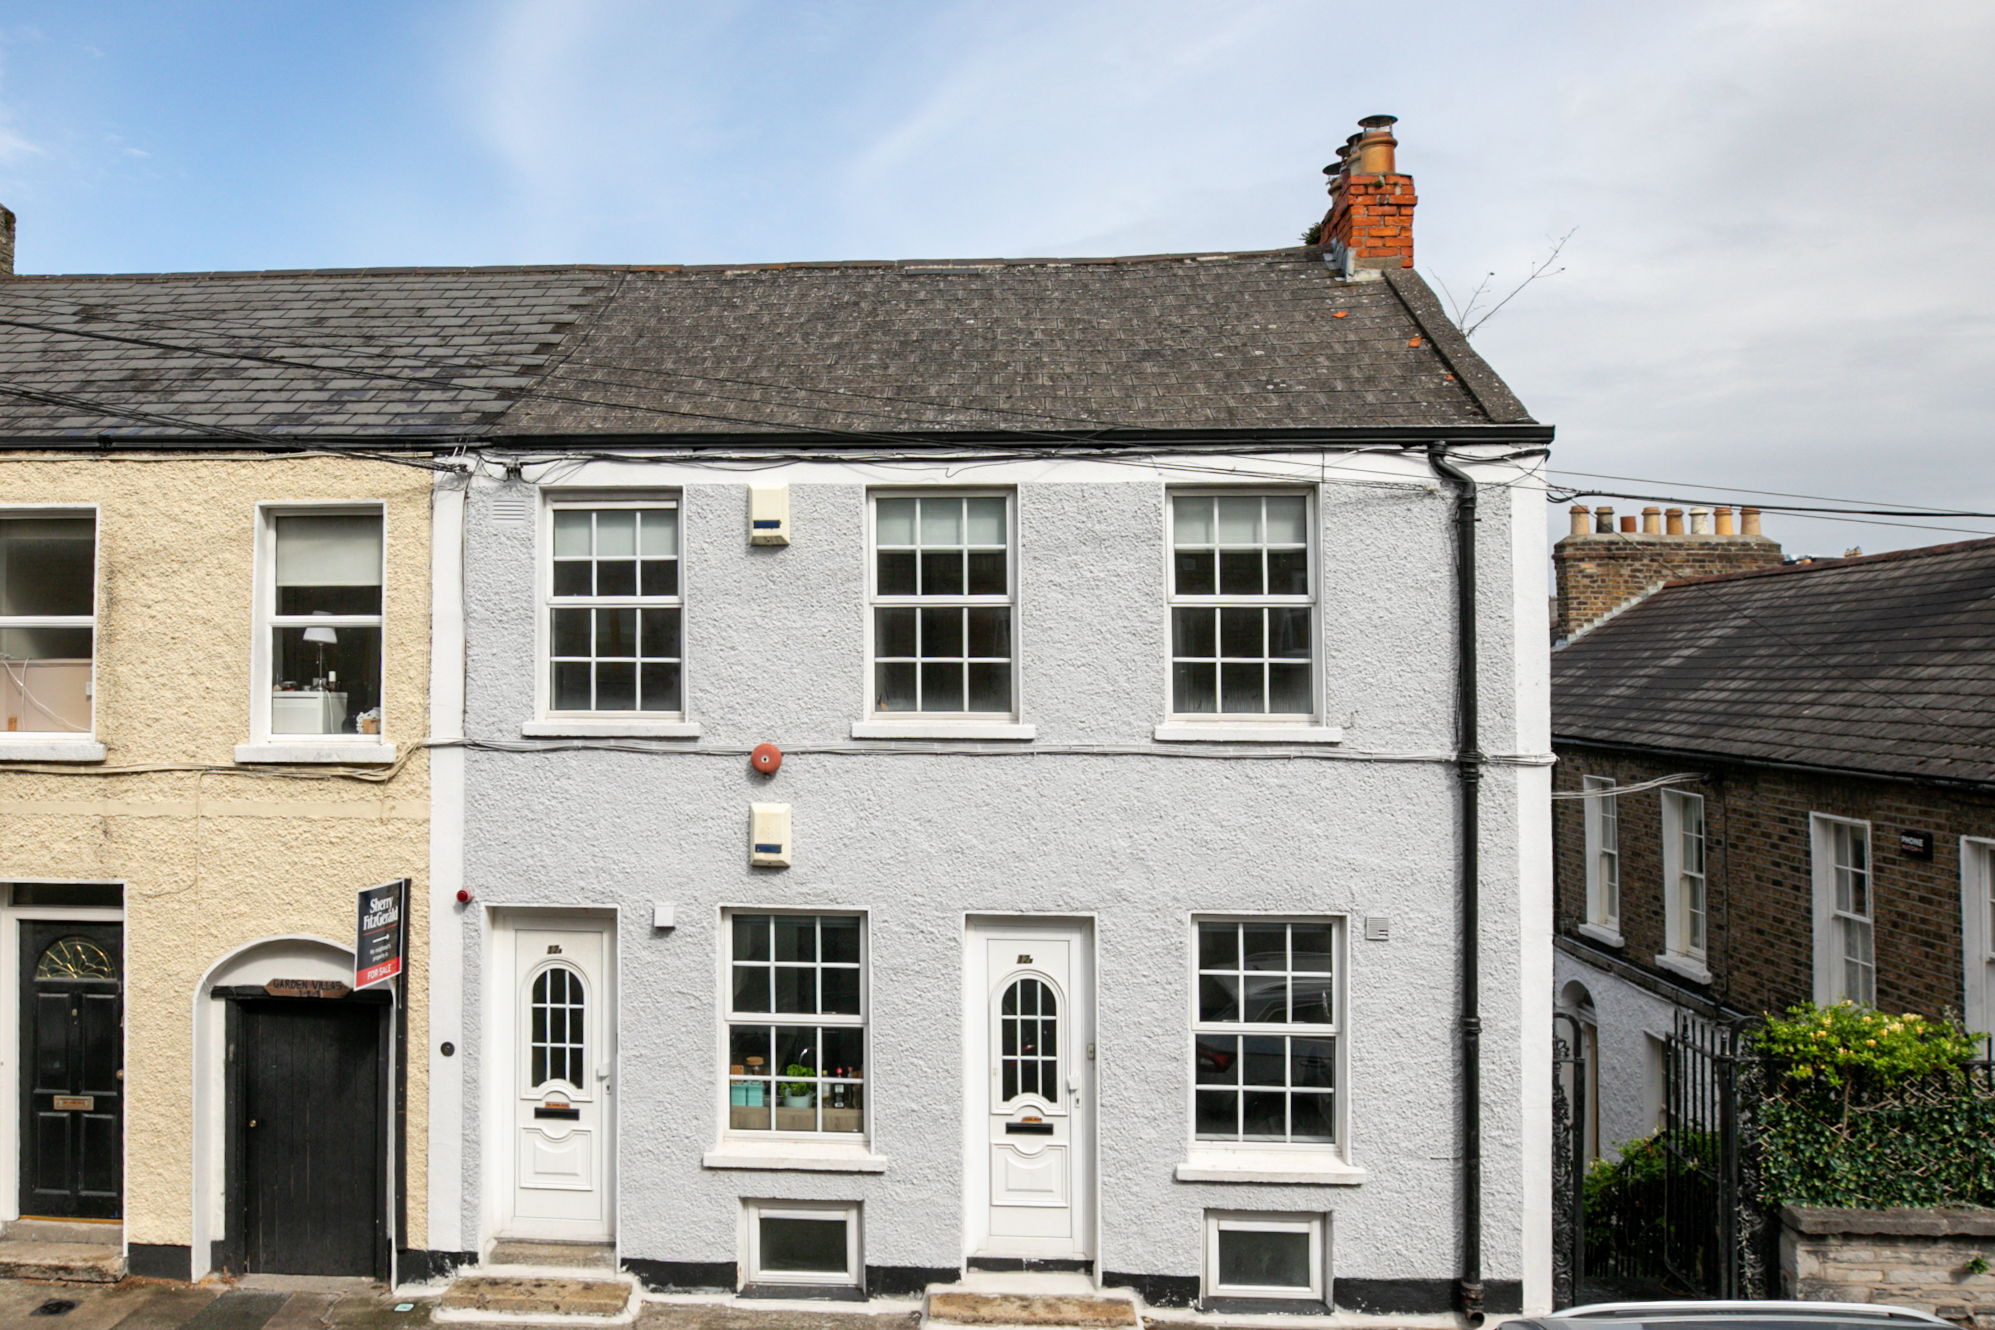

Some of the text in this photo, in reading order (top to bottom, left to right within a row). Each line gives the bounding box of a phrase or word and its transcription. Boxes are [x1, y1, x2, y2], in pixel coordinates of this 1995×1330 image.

[369, 897, 393, 913] Sherry
[363, 905, 398, 930] FitzGerald
[367, 963, 391, 980] FOR SALE
[273, 979, 308, 989] GARDEN
